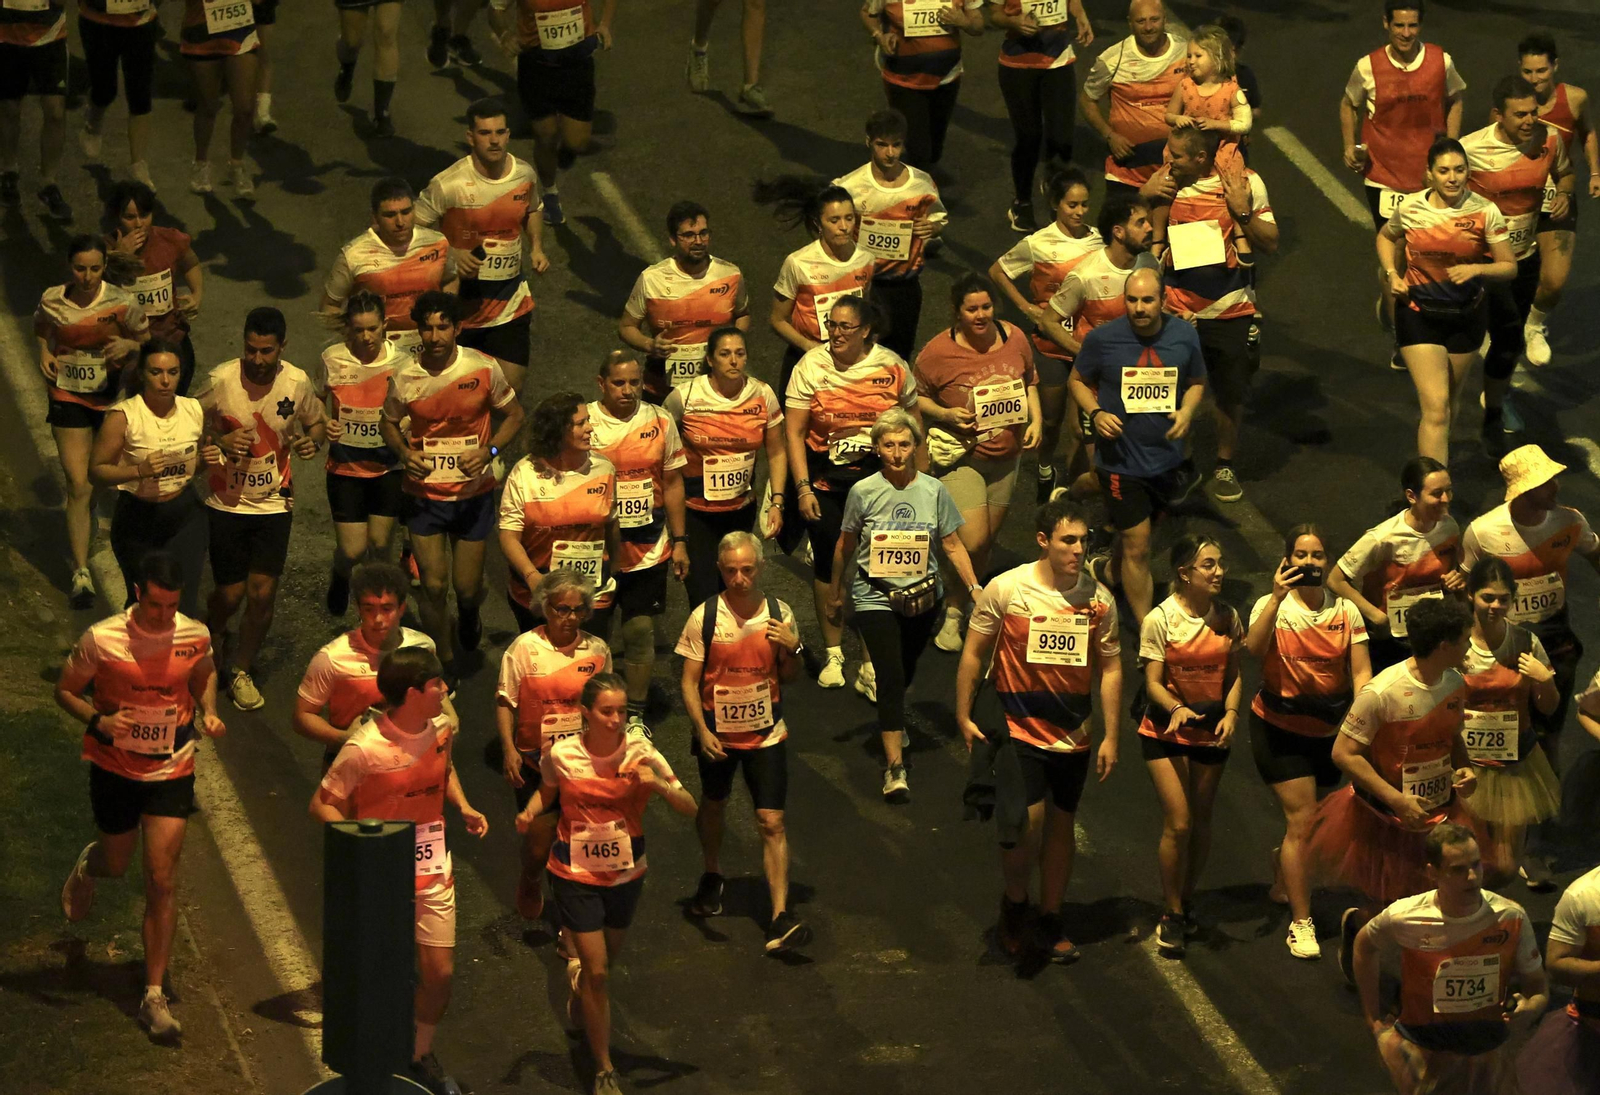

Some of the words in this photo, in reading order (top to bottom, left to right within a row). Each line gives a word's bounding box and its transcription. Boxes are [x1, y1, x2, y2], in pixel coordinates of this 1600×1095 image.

[210, 4, 248, 22] 17553
[543, 22, 578, 39] 19711
[867, 233, 900, 249] 9299
[137, 288, 169, 306] 9410
[64, 364, 96, 382] 3003
[1127, 385, 1169, 400] 20005
[981, 399, 1022, 418] 20006
[231, 471, 274, 487] 17950
[710, 469, 750, 488] 11896
[877, 550, 921, 565] 17930
[1512, 592, 1558, 612] 11502
[1038, 633, 1076, 651] 9390
[721, 700, 766, 720] 12735
[131, 724, 168, 741] 8881
[1466, 731, 1506, 748] 5728
[1409, 776, 1447, 798] 10583
[582, 842, 620, 858] 1465
[1445, 977, 1486, 997] 5734
